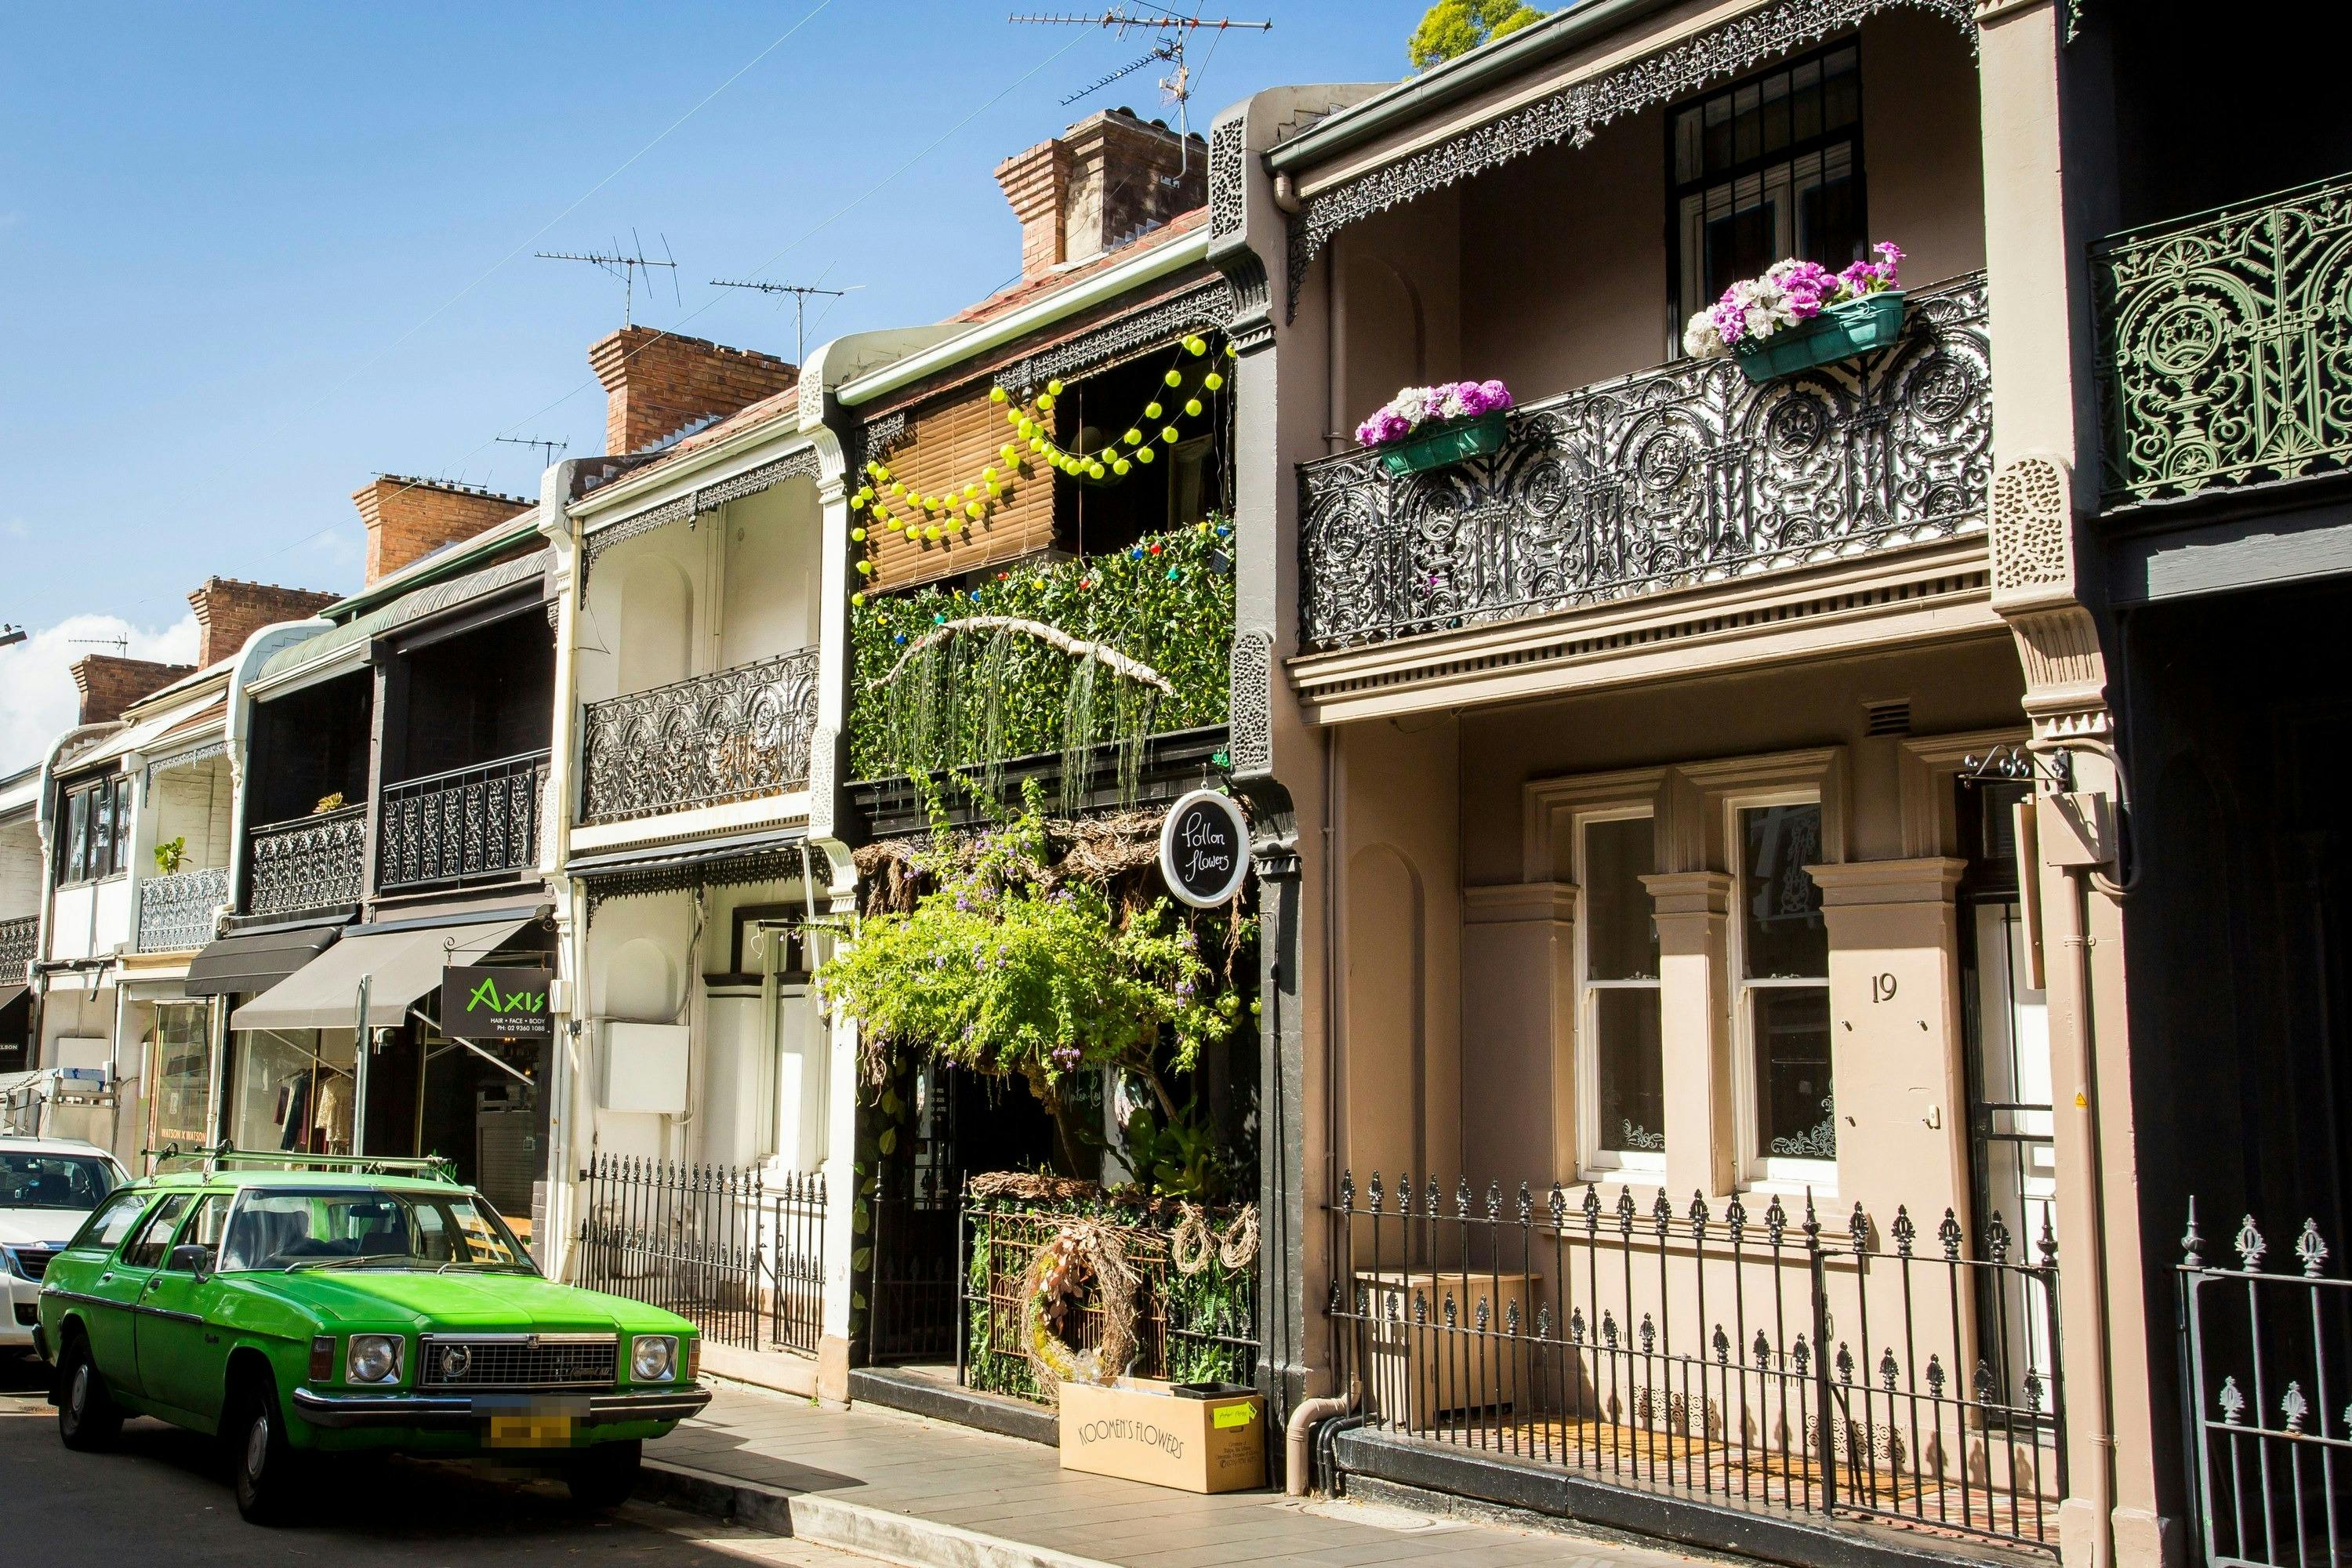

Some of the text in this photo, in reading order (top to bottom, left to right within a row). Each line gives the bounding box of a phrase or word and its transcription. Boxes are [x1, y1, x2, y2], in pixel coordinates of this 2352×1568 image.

[1871, 972, 1897, 1004] 19
[161, 1128, 180, 1139] WATSON
[187, 1131, 206, 1142] WATSON
[1078, 1418, 1184, 1459] KOOMEN'S FLOWERS
